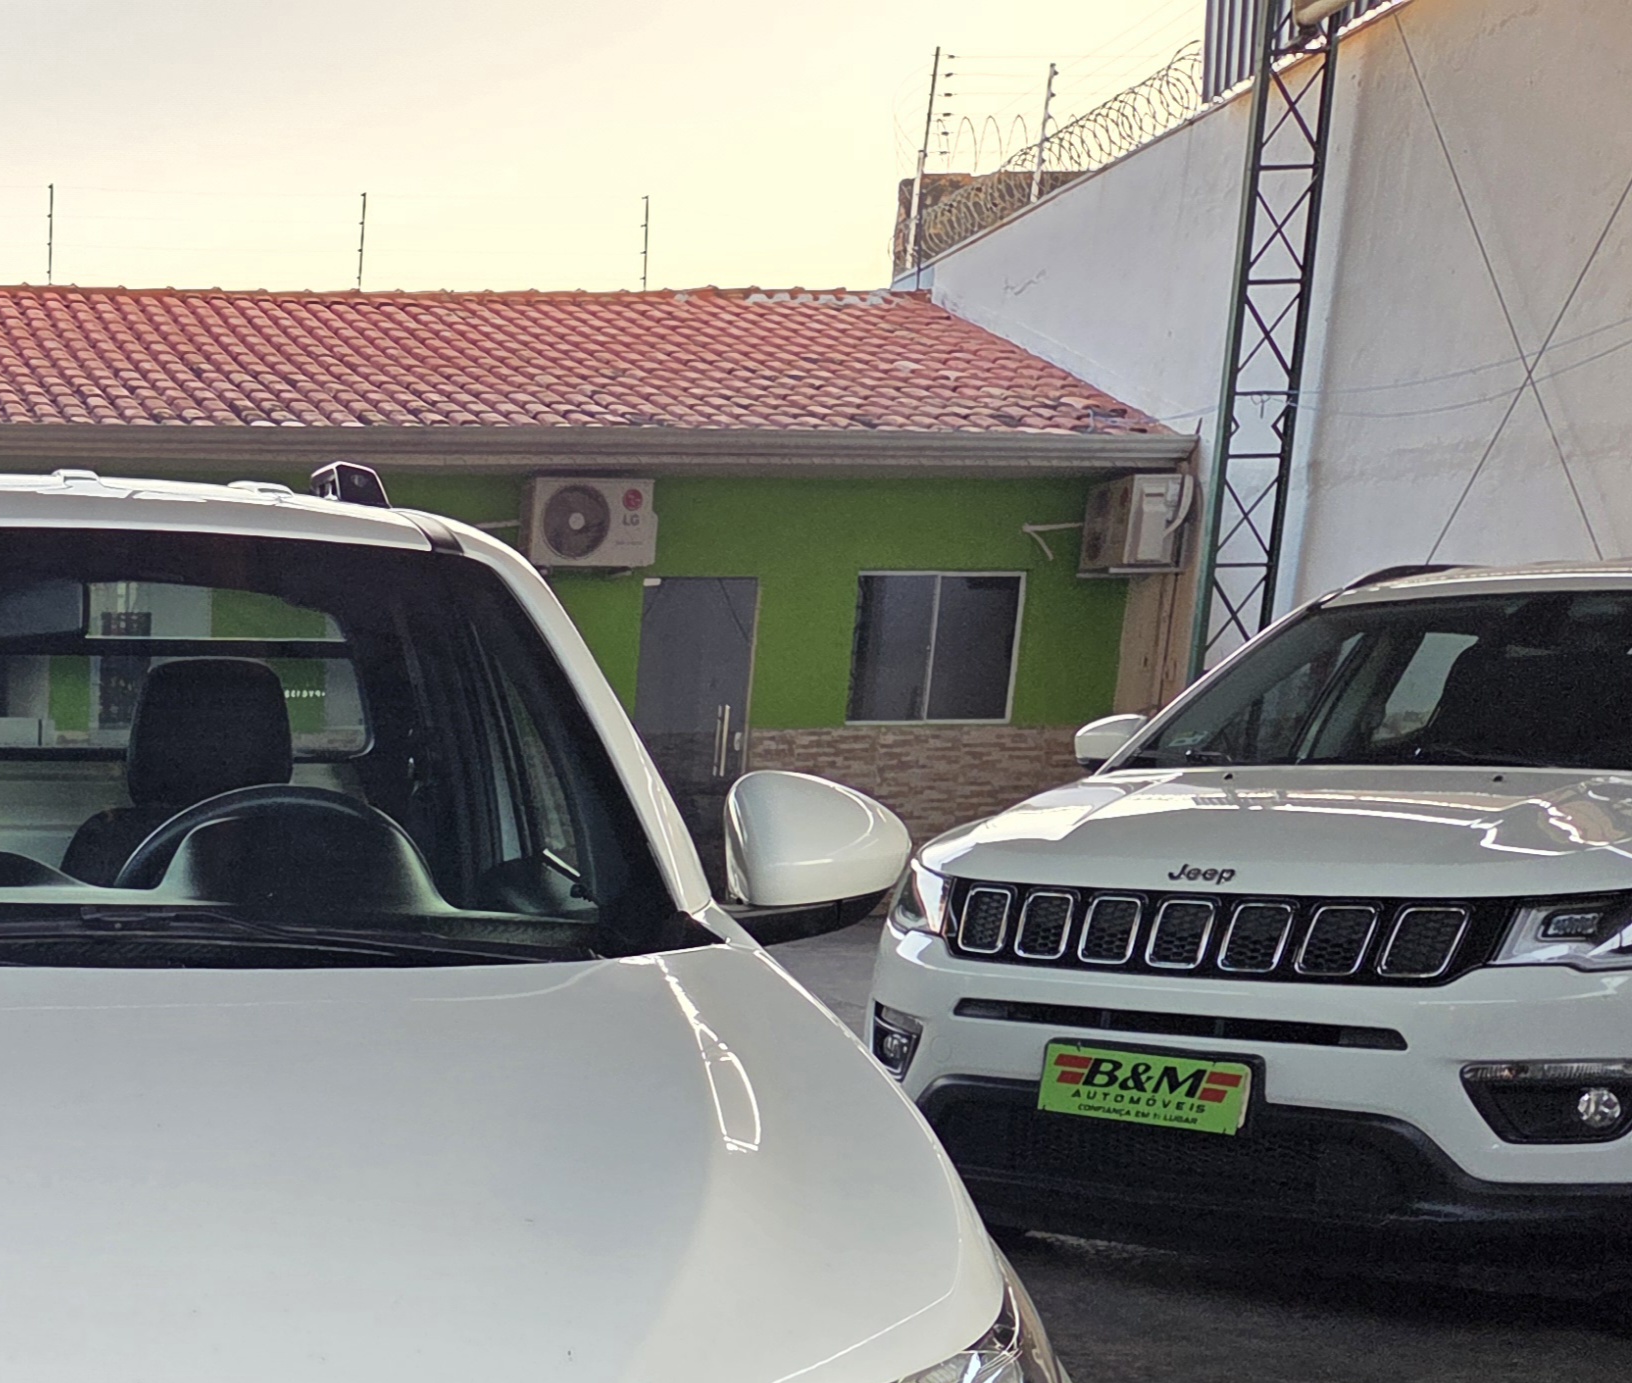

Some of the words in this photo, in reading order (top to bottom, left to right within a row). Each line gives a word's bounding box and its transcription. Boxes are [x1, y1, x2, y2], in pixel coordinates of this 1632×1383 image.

[622, 513, 640, 527] LG
[1168, 863, 1235, 885] Jeep
[1082, 1057, 1207, 1098] B&M
[1071, 1088, 1206, 1114] AUTOMÓVEIS
[1077, 1103, 1131, 1117] CONFIANÇA
[1135, 1110, 1150, 1119] EM
[1163, 1114, 1198, 1125] LUGAR
